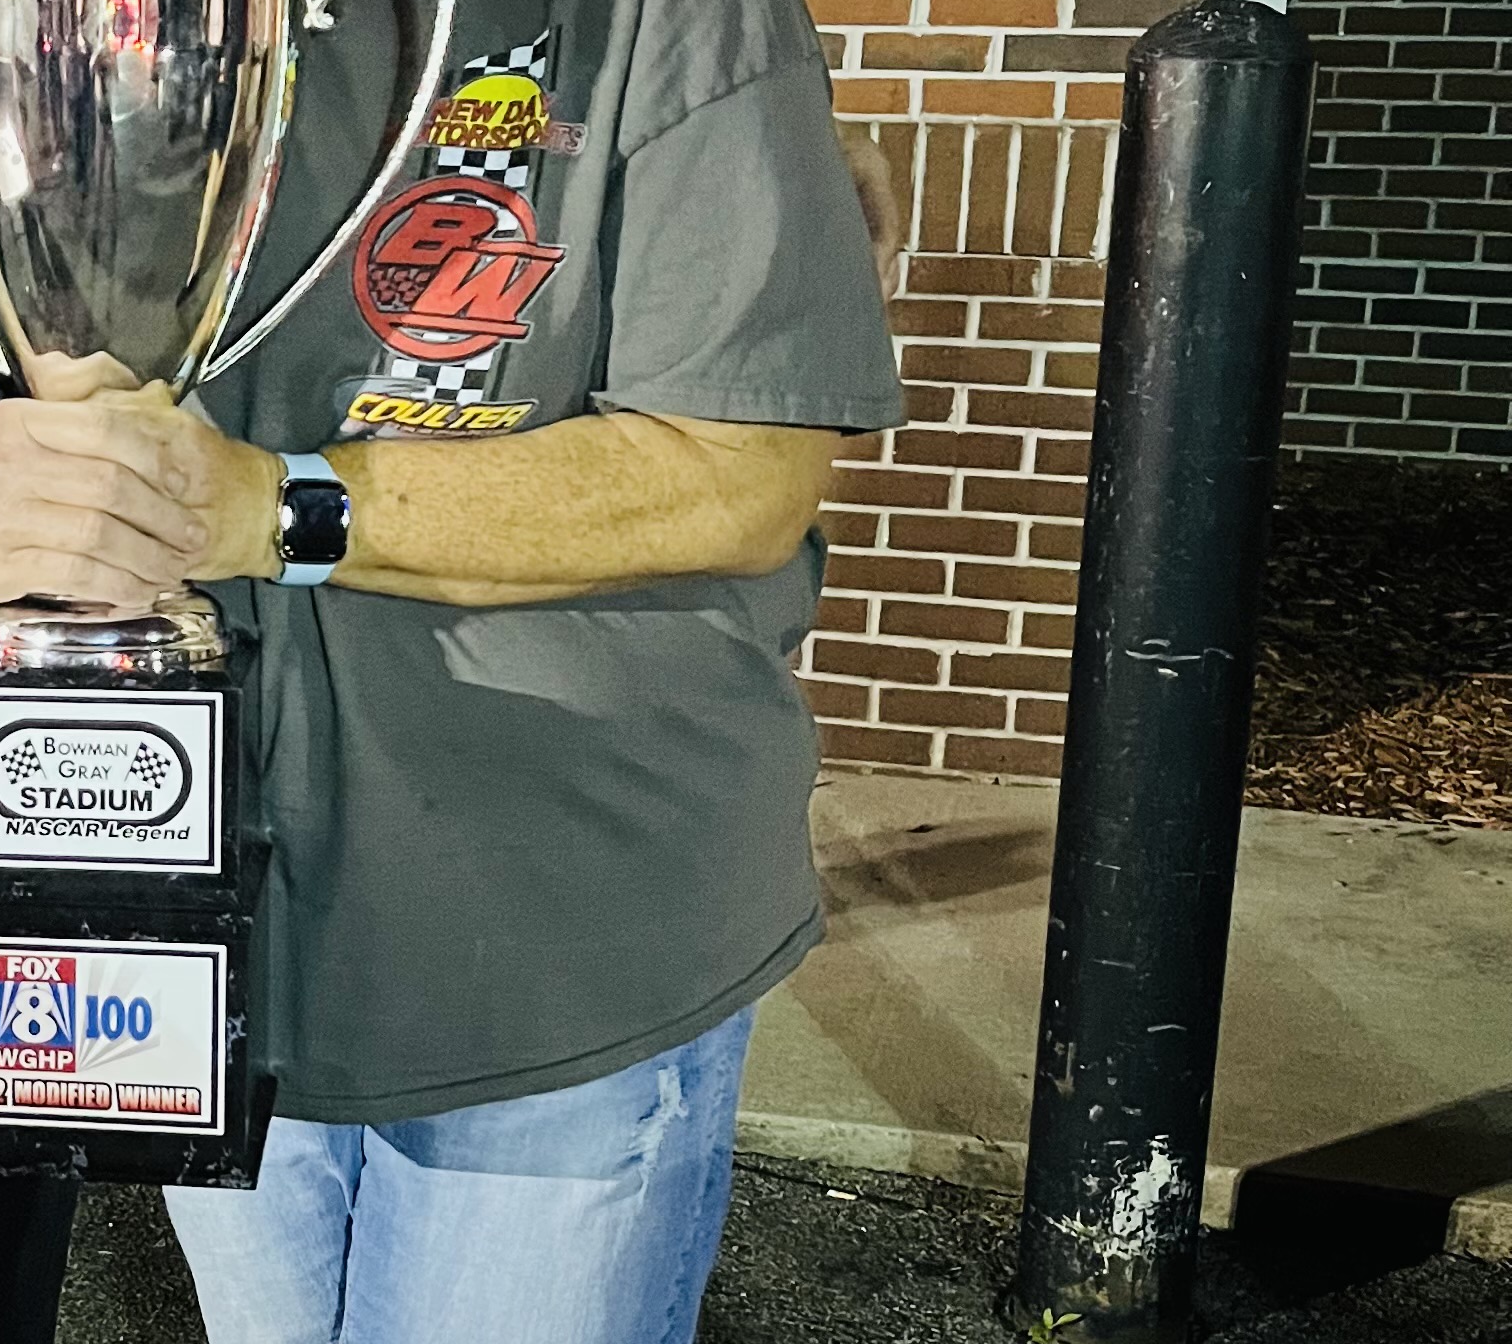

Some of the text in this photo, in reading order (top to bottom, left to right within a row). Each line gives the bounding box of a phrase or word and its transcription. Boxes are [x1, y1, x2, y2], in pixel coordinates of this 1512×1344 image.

[431, 98, 502, 124] NEW
[20, 786, 154, 812] STADIUM
[5, 819, 101, 838] NASCAR
[107, 821, 191, 842] Legend
[6, 956, 61, 981] FOX
[11, 987, 58, 1044] 8
[85, 994, 152, 1043] 100
[12, 1078, 112, 1110] MODIFIED
[115, 1083, 202, 1115] WINNER
